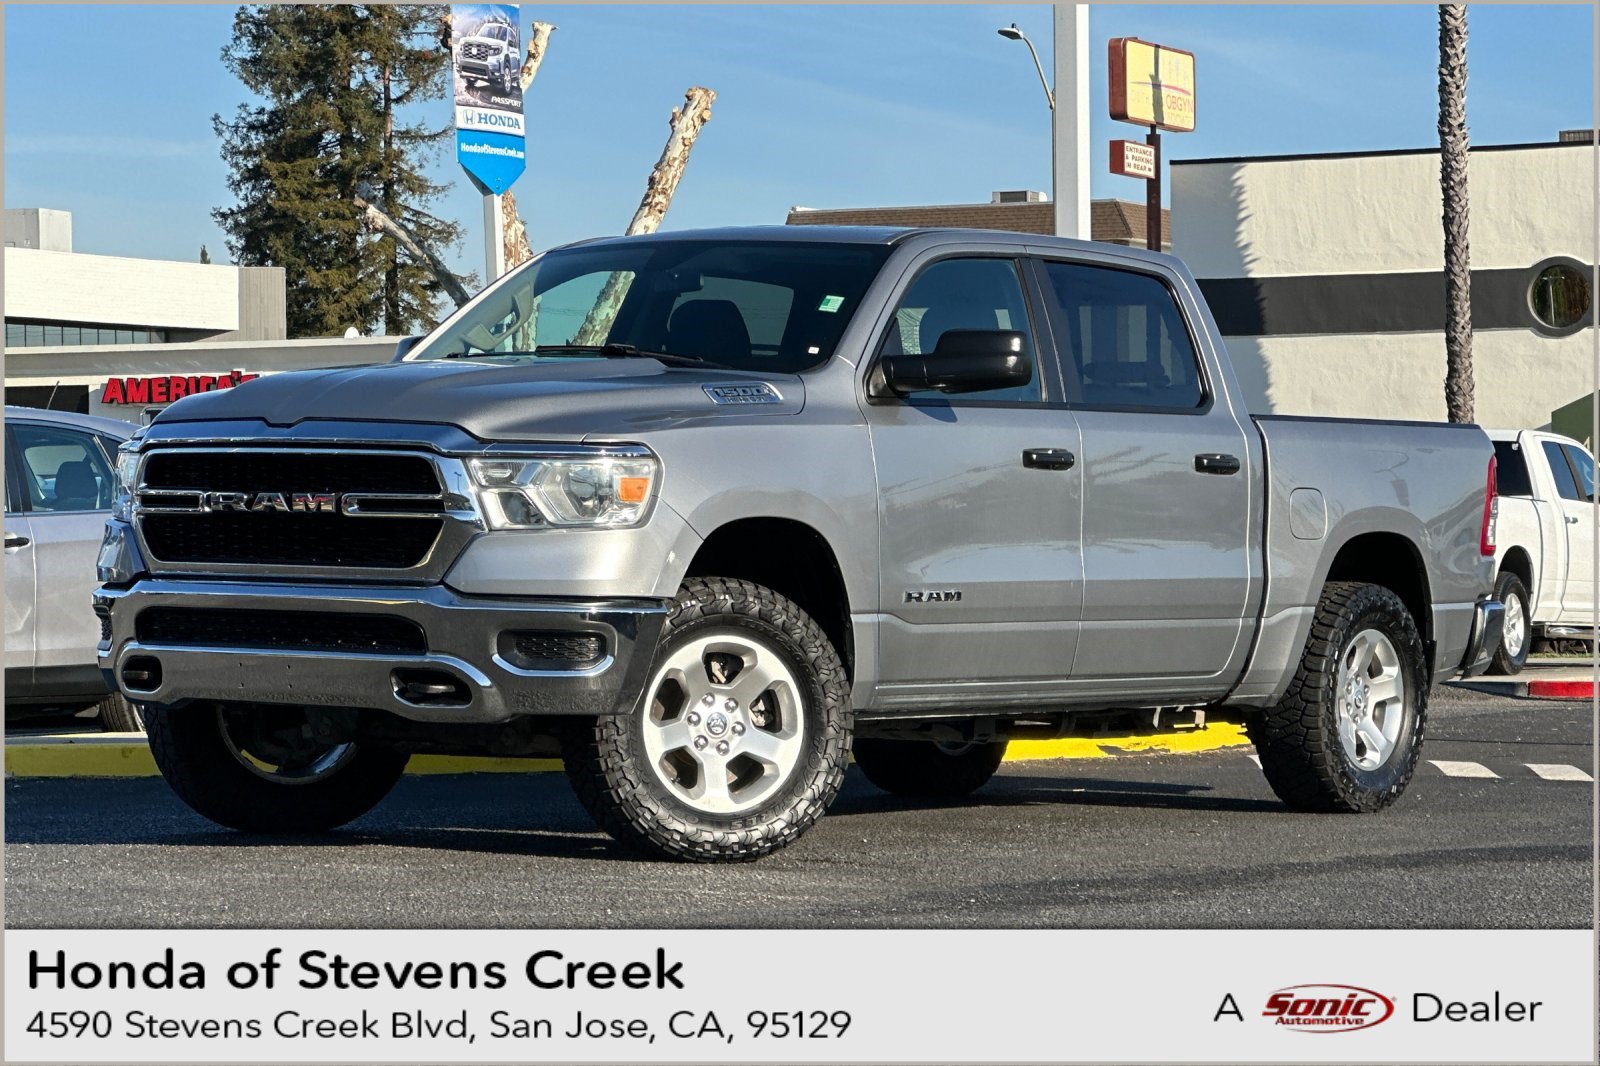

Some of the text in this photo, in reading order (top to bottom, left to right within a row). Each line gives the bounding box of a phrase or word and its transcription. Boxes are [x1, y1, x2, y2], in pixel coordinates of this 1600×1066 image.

[491, 96, 521, 107] PASSPORT
[1166, 94, 1193, 113] OBGYN
[477, 113, 520, 129] HONDA
[1126, 146, 1152, 156] ENTRANCE
[1132, 155, 1152, 165] PARKING
[1133, 164, 1146, 172] REAR
[101, 370, 260, 405] AMERICA'
[714, 386, 764, 396] 1500
[210, 491, 336, 512] RAM
[903, 590, 962, 603] RAM
